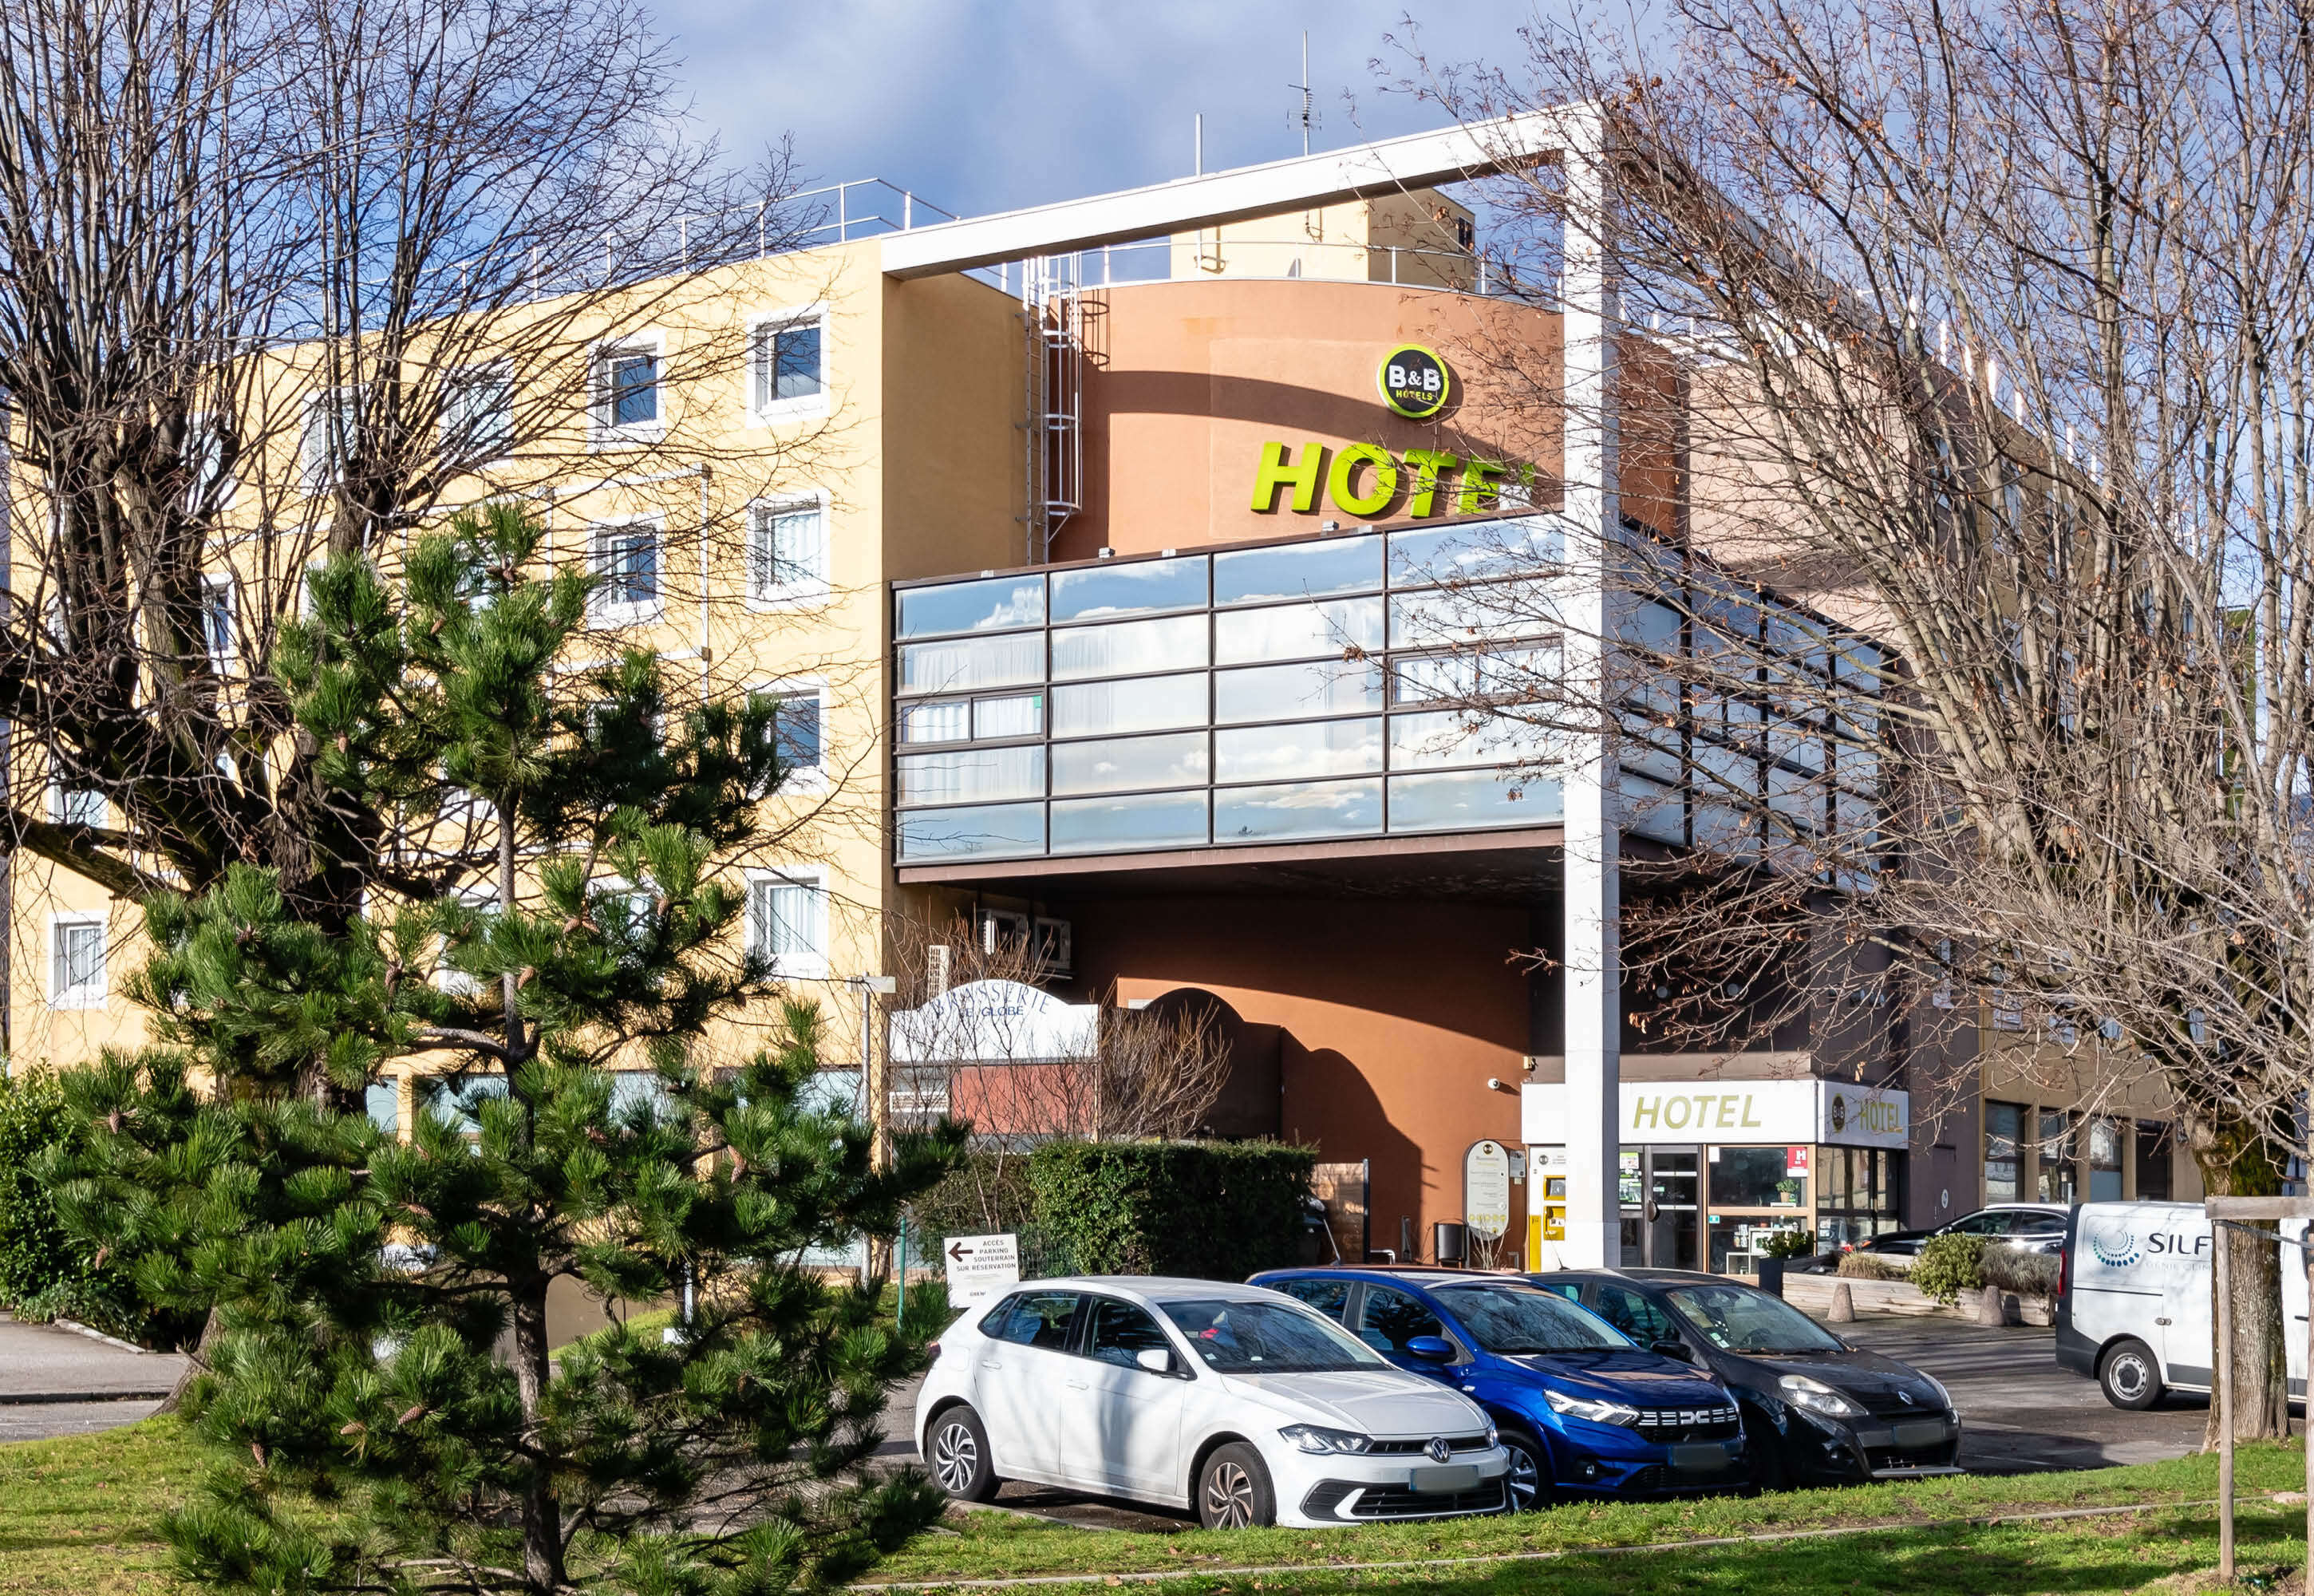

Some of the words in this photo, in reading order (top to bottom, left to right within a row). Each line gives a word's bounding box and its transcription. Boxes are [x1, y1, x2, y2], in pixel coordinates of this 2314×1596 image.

[1388, 365, 1441, 391] B&B
[1396, 389, 1433, 401] HOTELS
[931, 982, 1052, 1017] BRASSERIE
[981, 1005, 1024, 1017] GLOBE
[1633, 1095, 1761, 1129] HOTEL
[1859, 1100, 1903, 1133] HOTEL
[2146, 1232, 2212, 1254] SILF
